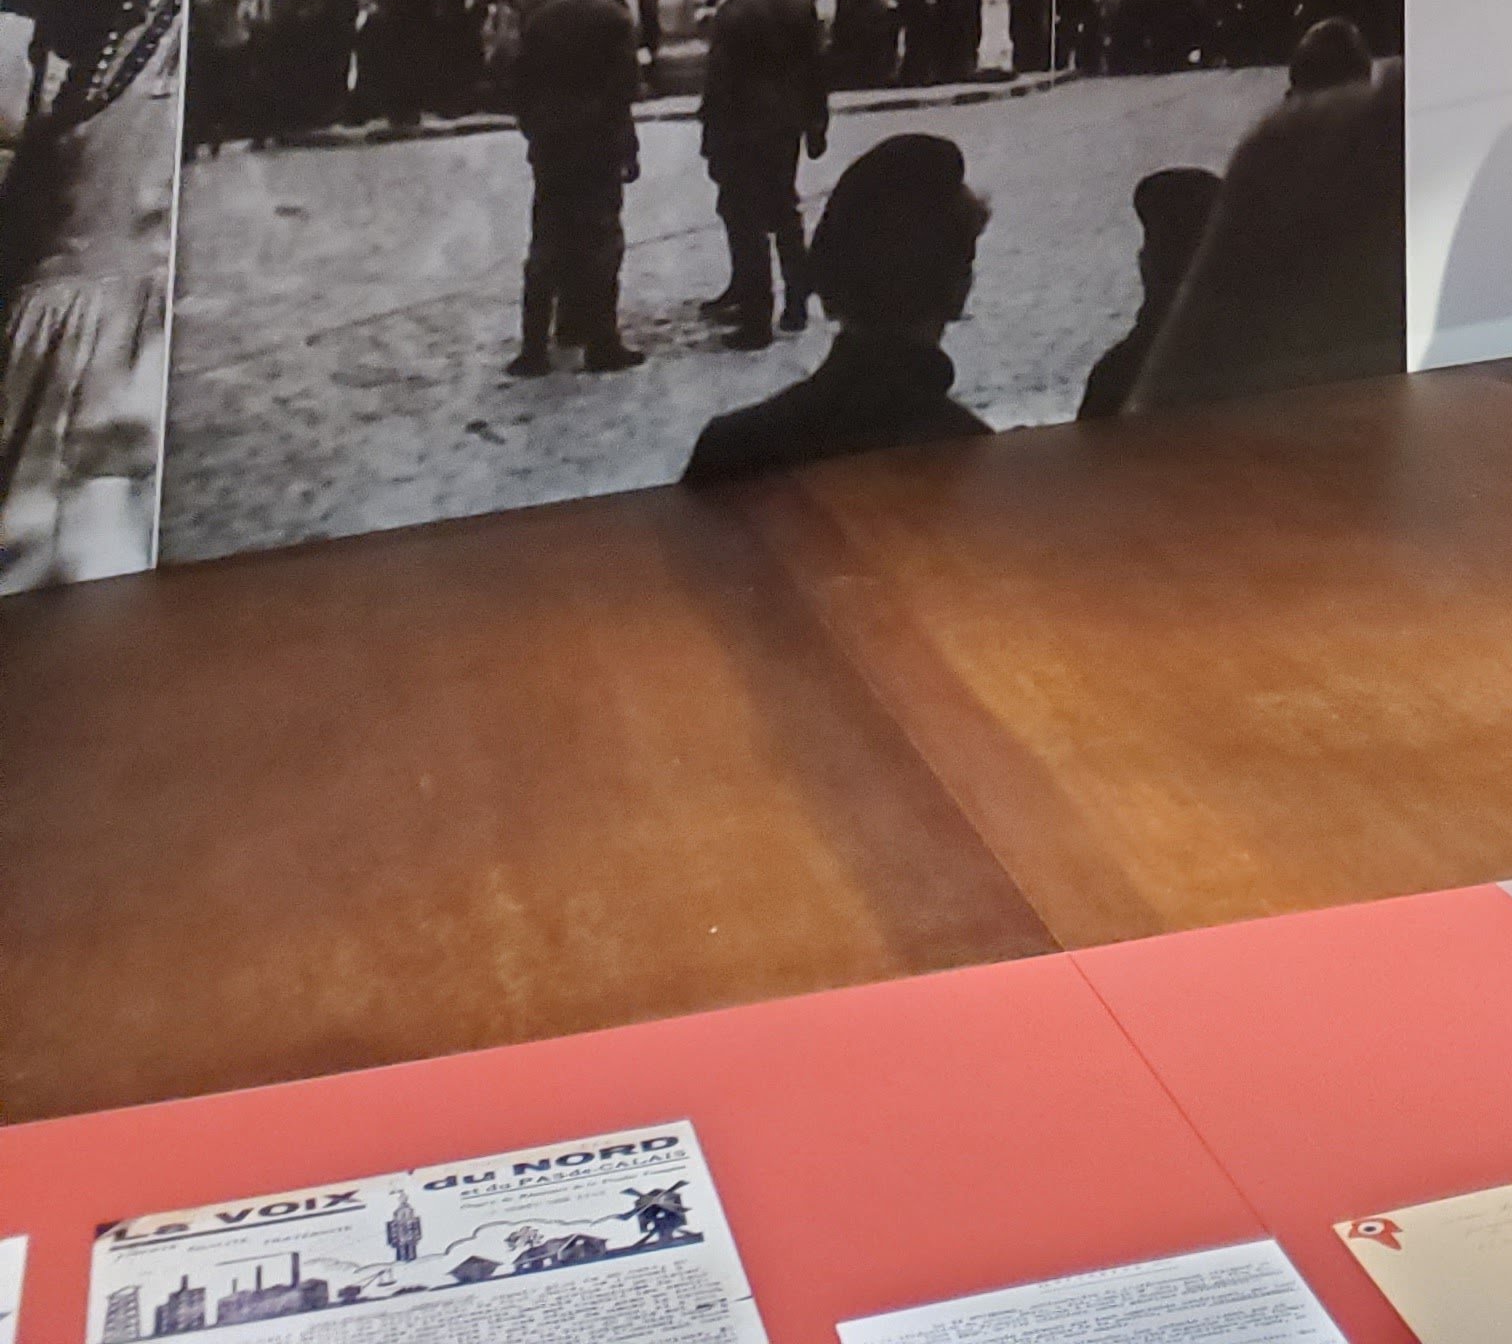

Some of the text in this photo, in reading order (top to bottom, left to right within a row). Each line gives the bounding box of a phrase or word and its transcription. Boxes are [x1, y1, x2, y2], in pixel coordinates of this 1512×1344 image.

[422, 1170, 496, 1192] du
[512, 1135, 679, 1176] NORD
[214, 1190, 360, 1224] VOIX
